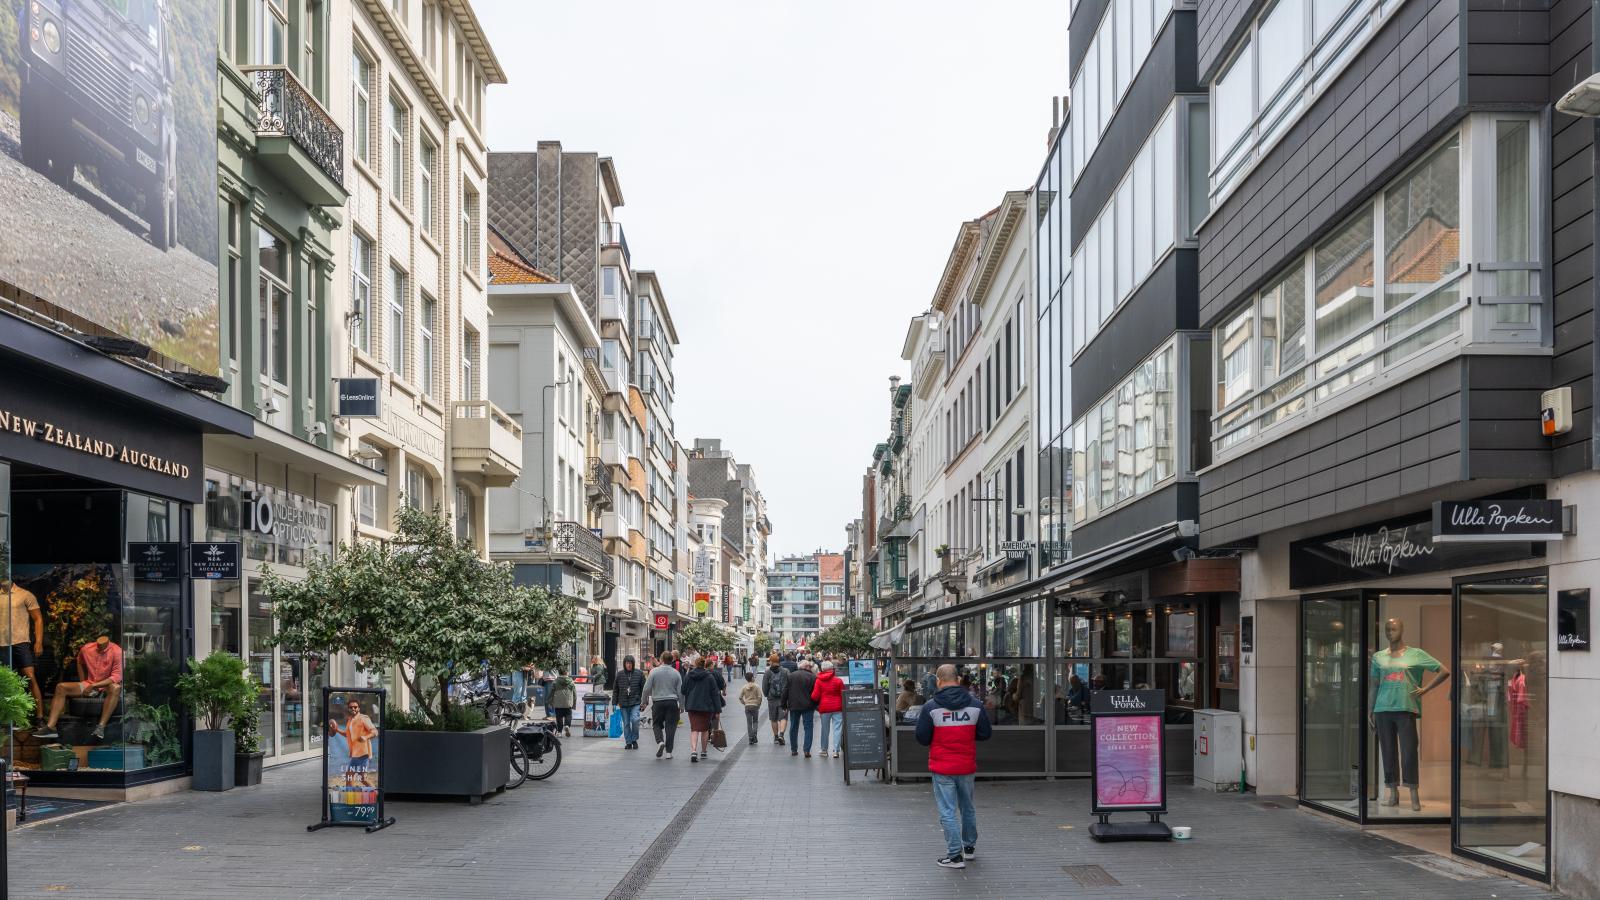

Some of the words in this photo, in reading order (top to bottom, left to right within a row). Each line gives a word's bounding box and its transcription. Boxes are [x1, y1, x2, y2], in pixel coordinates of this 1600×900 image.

[0, 411, 37, 437] NEW
[44, 423, 114, 458] ZEALAND
[120, 446, 189, 479] AUCKLAND
[274, 502, 327, 530] INDEPENDENT
[1452, 504, 1486, 526] Ulla
[1488, 504, 1554, 532] Popken
[1350, 531, 1376, 568] Ulla
[1378, 526, 1434, 574] Popken
[1110, 696, 1139, 705] ULLA
[1114, 700, 1146, 709] POPKEN
[942, 712, 970, 722] FILA
